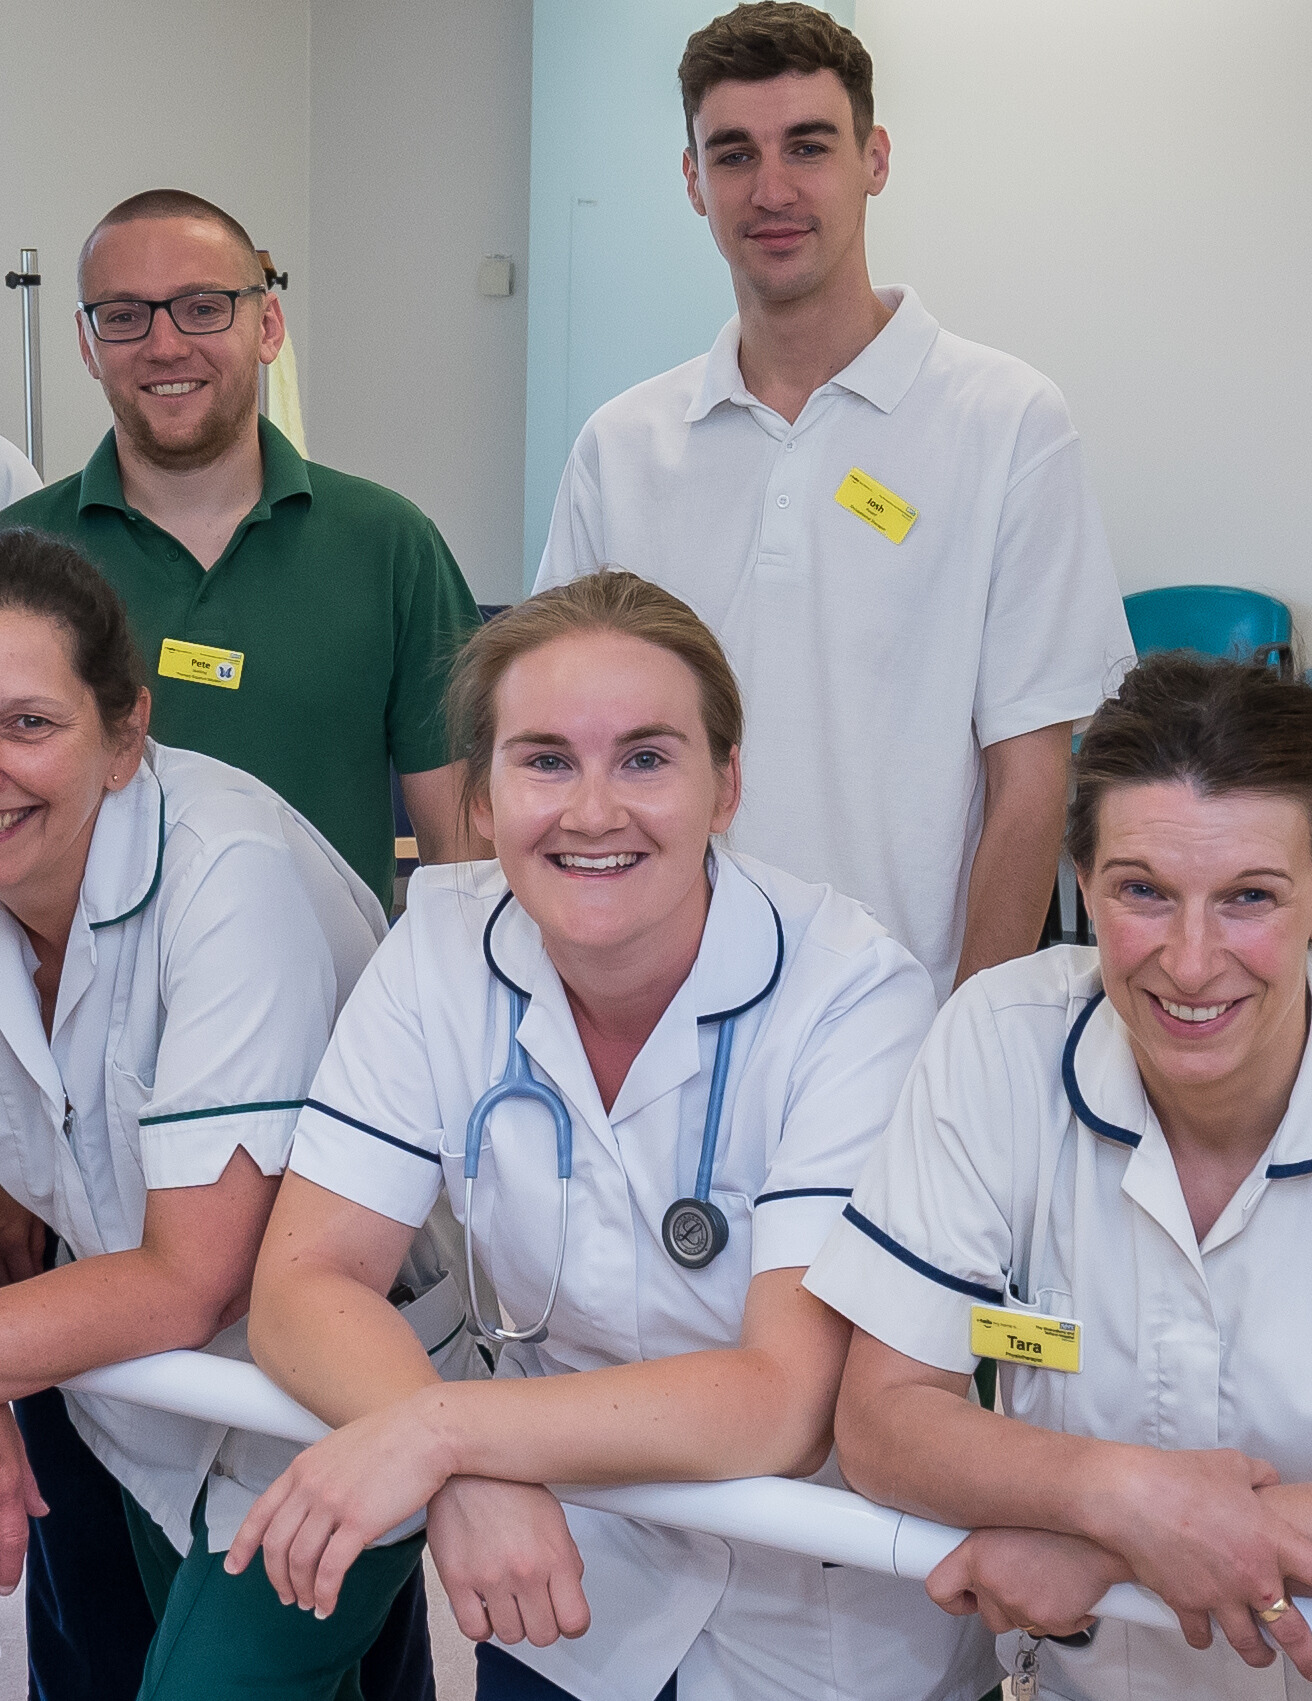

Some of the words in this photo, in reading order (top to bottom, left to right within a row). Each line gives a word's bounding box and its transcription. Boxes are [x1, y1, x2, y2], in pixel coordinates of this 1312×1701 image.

[866, 498, 884, 513] Josh
[191, 658, 211, 669] Pete
[1006, 1335, 1042, 1354] Tara
